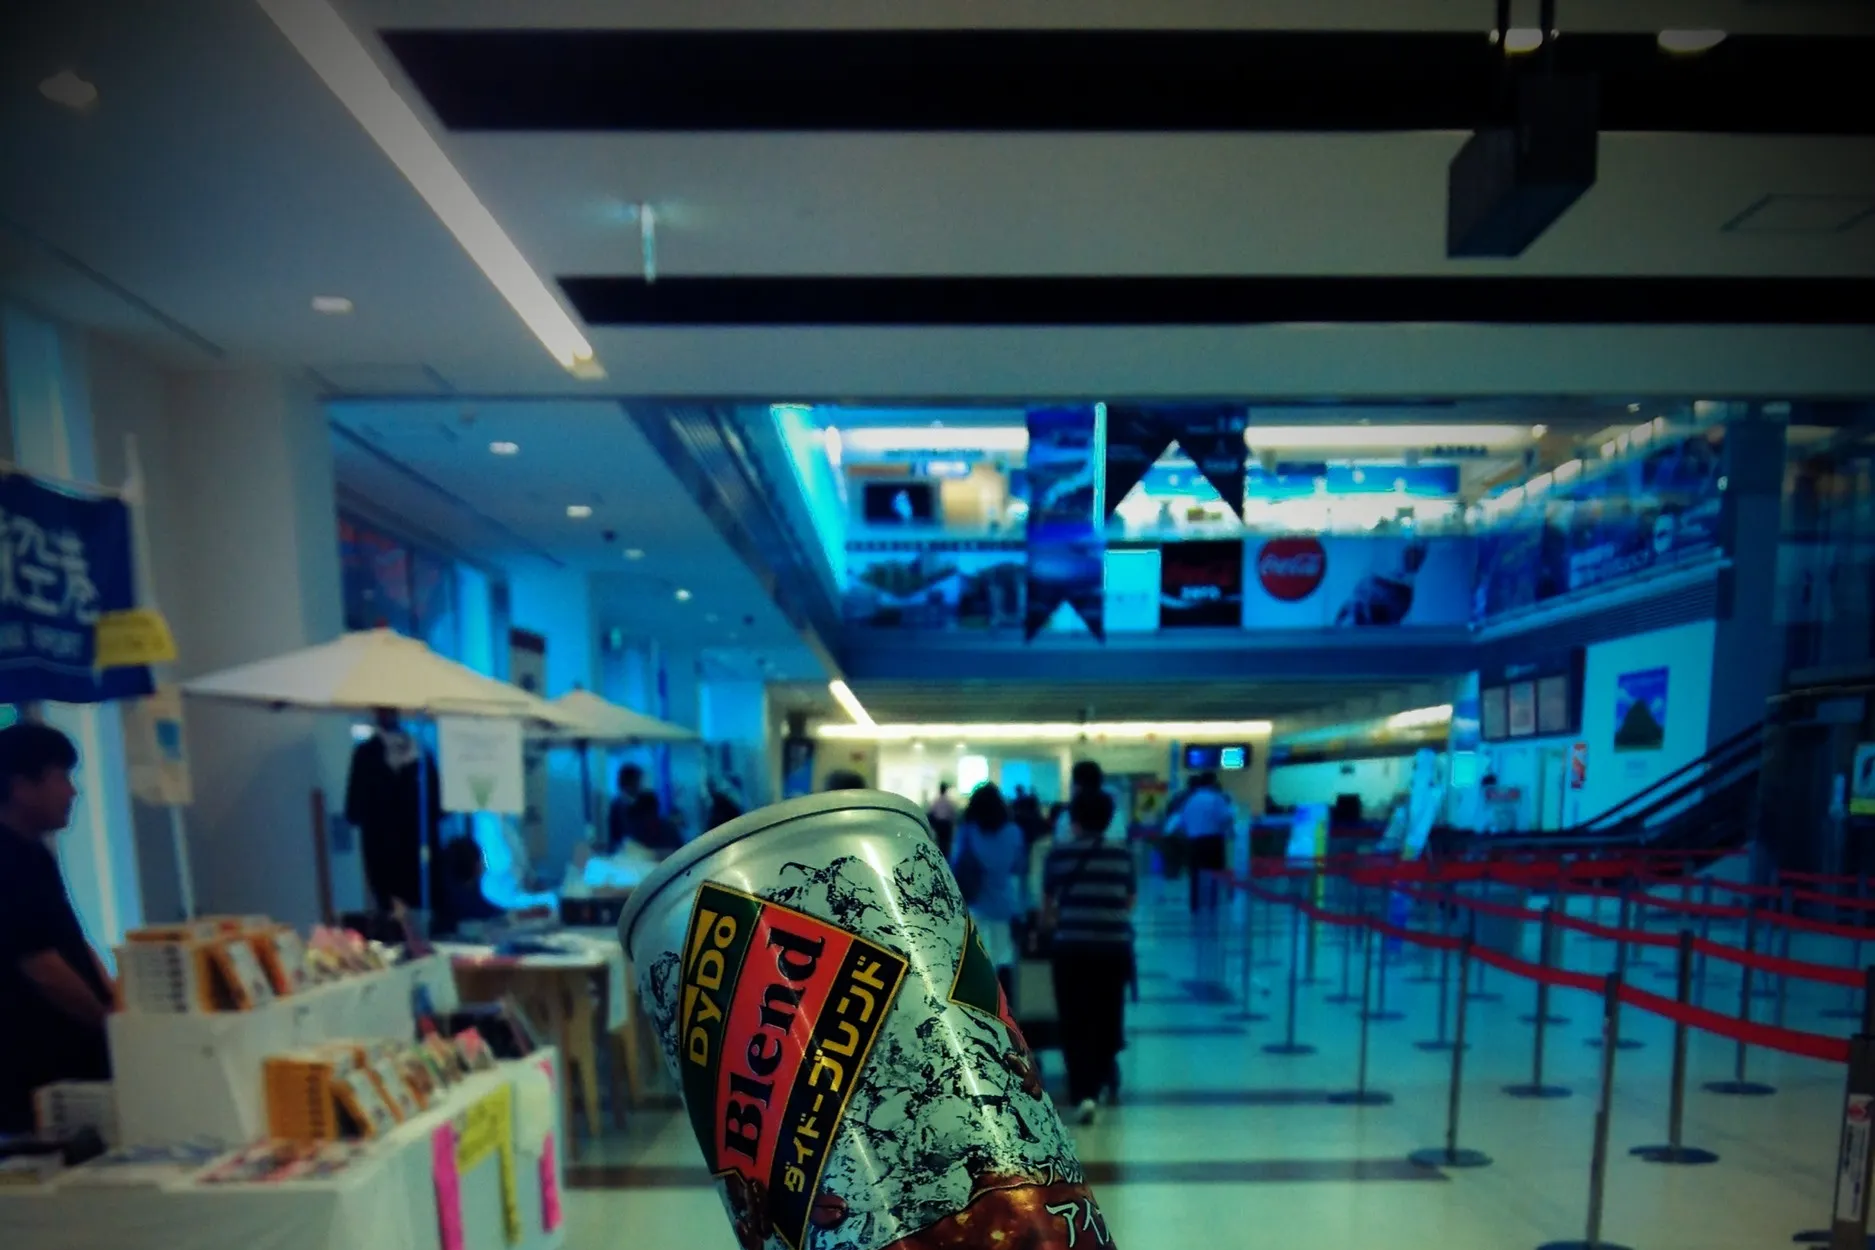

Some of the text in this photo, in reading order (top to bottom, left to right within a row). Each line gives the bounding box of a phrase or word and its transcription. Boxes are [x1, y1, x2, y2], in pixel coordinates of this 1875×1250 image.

[724, 926, 827, 1169] Blend
[783, 954, 886, 1194] ダイドーブレンド
